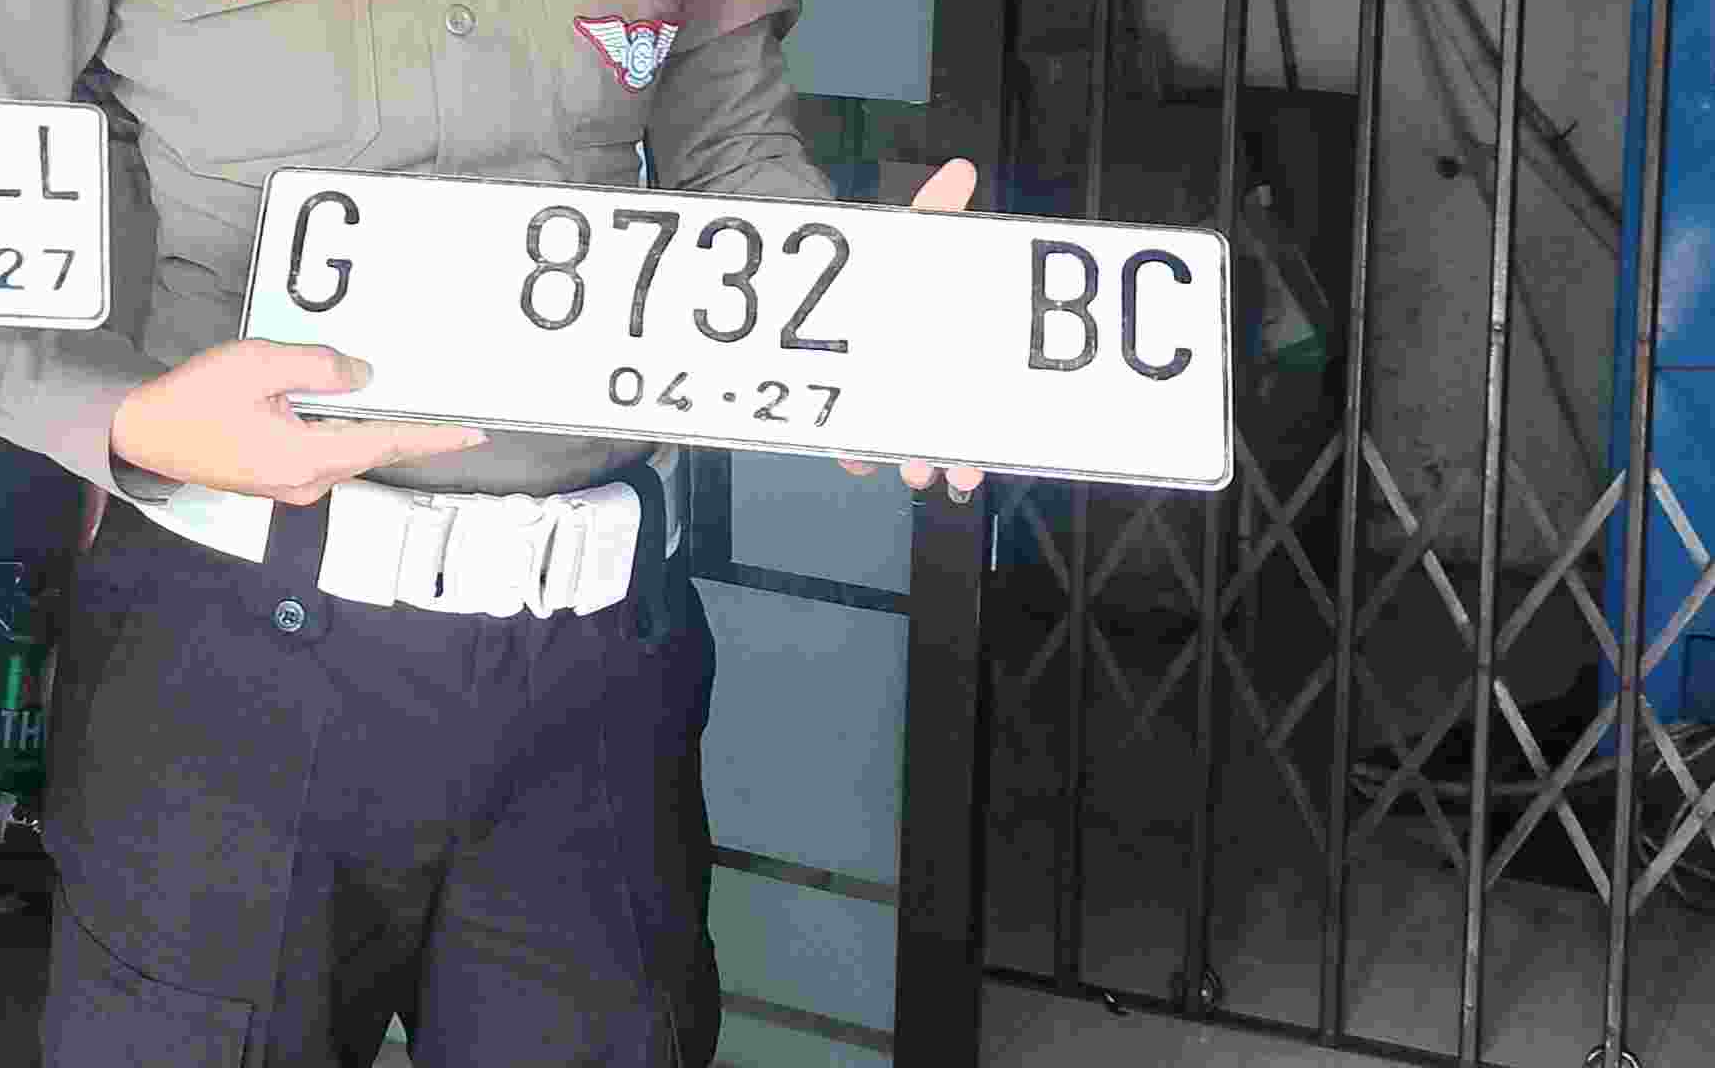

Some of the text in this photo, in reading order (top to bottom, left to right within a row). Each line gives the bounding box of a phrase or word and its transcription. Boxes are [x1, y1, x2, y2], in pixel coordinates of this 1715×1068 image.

[285, 189, 1194, 382] G 8732 BC
